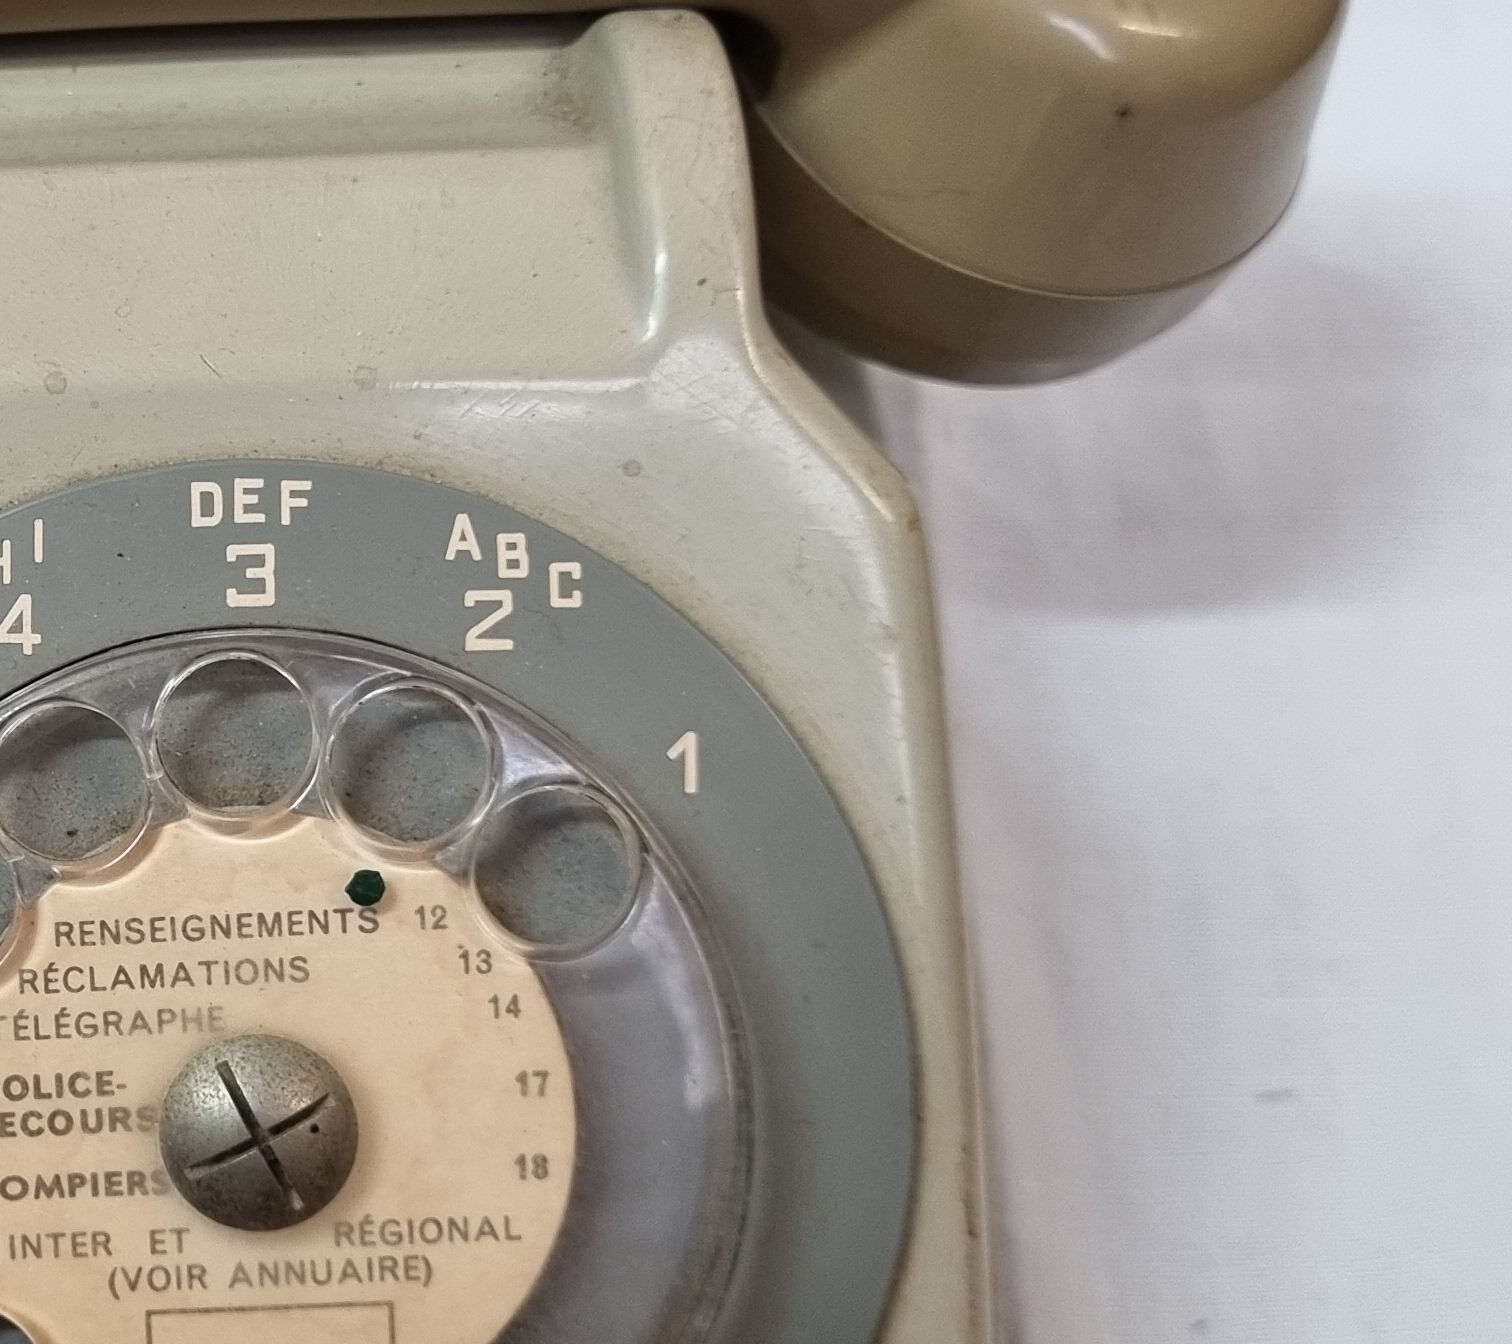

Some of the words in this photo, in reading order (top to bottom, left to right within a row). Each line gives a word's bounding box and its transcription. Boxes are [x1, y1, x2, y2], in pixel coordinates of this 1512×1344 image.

[225, 543, 276, 608] 3
[463, 588, 515, 653] 2
[665, 730, 701, 795] 1
[53, 906, 381, 948] RENSEIGNEMENTS
[413, 904, 449, 931] 12
[17, 954, 311, 995] RÉCLAMATIONS
[459, 948, 493, 976] 13
[487, 993, 523, 1020] 14
[514, 1069, 550, 1098] 17
[513, 1153, 550, 1182] 18
[7, 1230, 113, 1260] INTER
[149, 1227, 190, 1255] ET
[332, 1213, 523, 1248] RÉGIONAL
[107, 1261, 209, 1301] (VOIR
[227, 1254, 435, 1290] ANNUAIRE)
